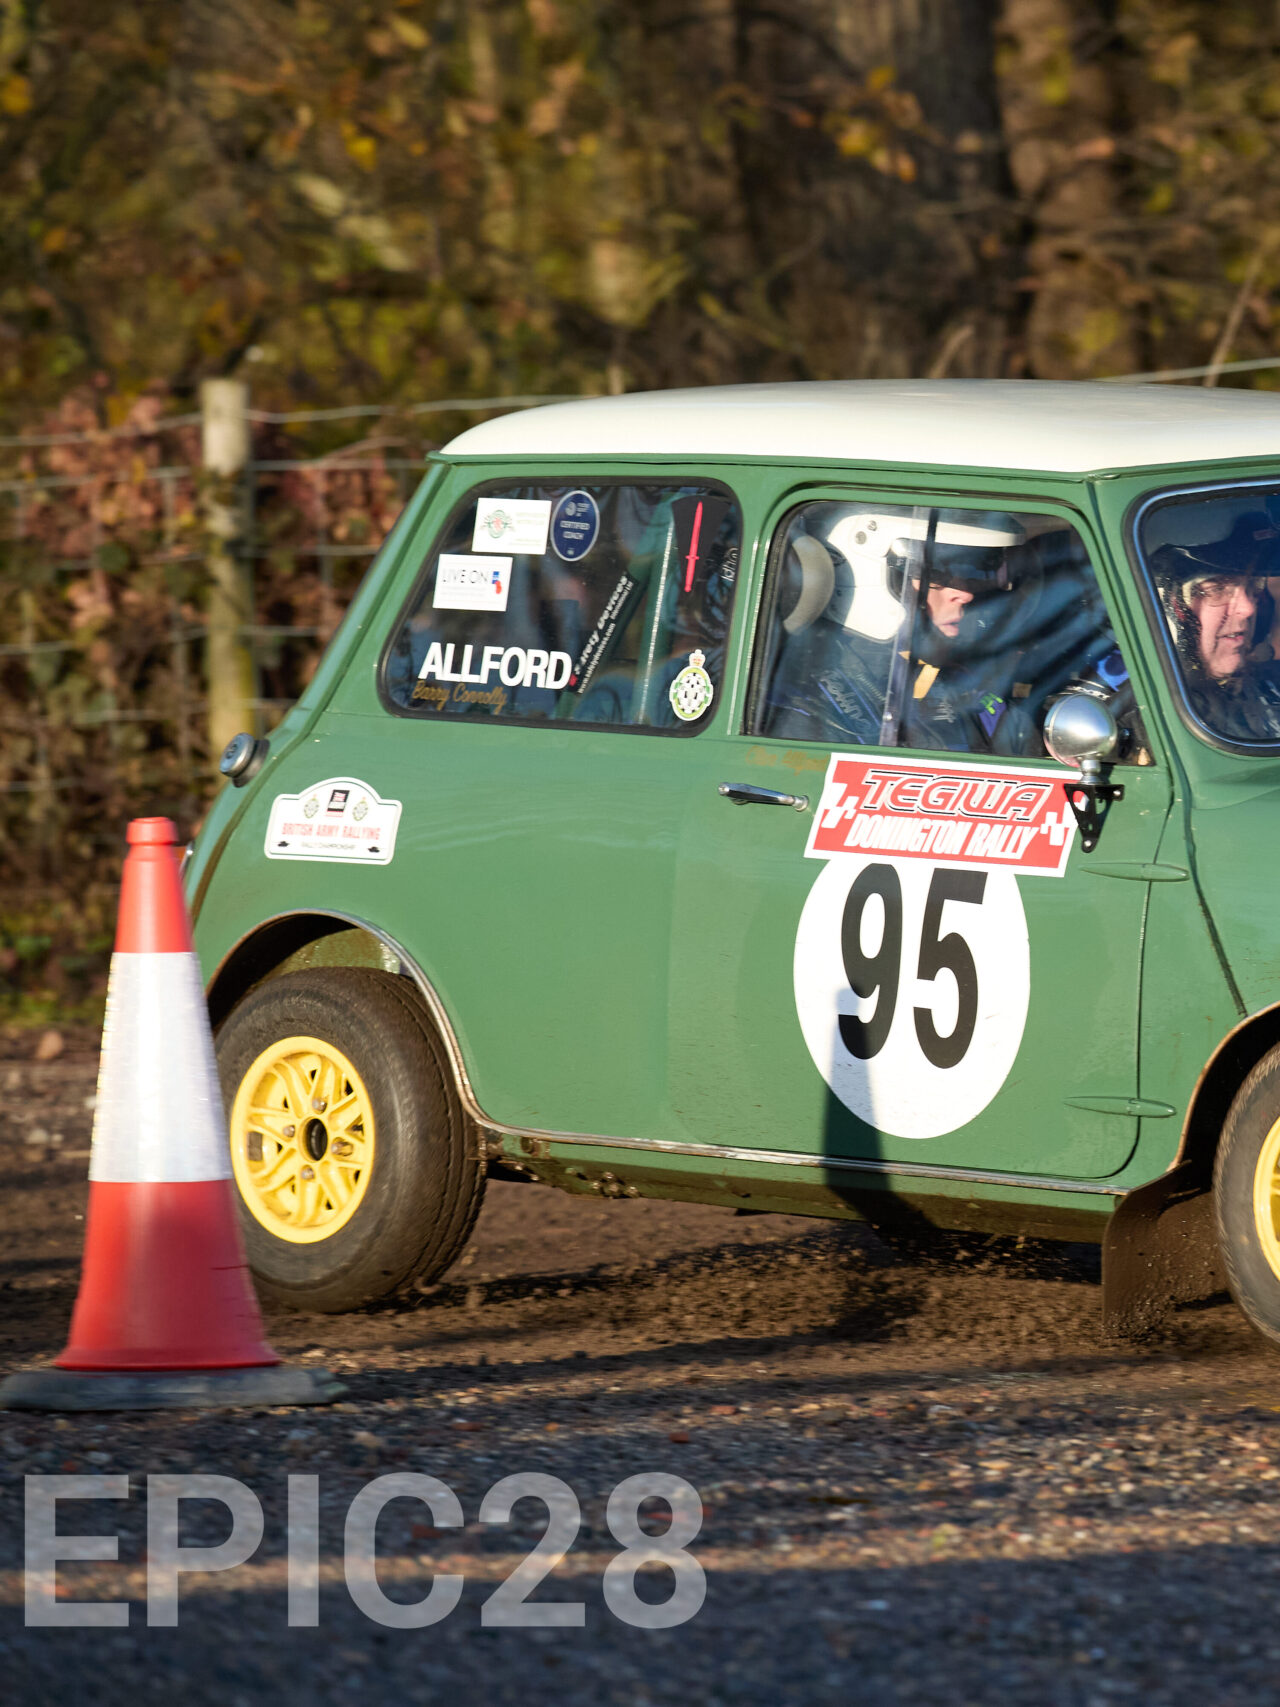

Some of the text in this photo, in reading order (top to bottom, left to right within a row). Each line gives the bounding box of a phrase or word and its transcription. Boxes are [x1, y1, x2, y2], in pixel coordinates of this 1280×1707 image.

[418, 642, 572, 690] ALLFORD
[412, 680, 507, 715] Barry Connolly
[861, 769, 1054, 822] TEGWA
[281, 823, 381, 840] BRITISH ARMY RALLYING
[844, 814, 1040, 859] DONINGTON RALLY
[838, 863, 988, 1069] 95
